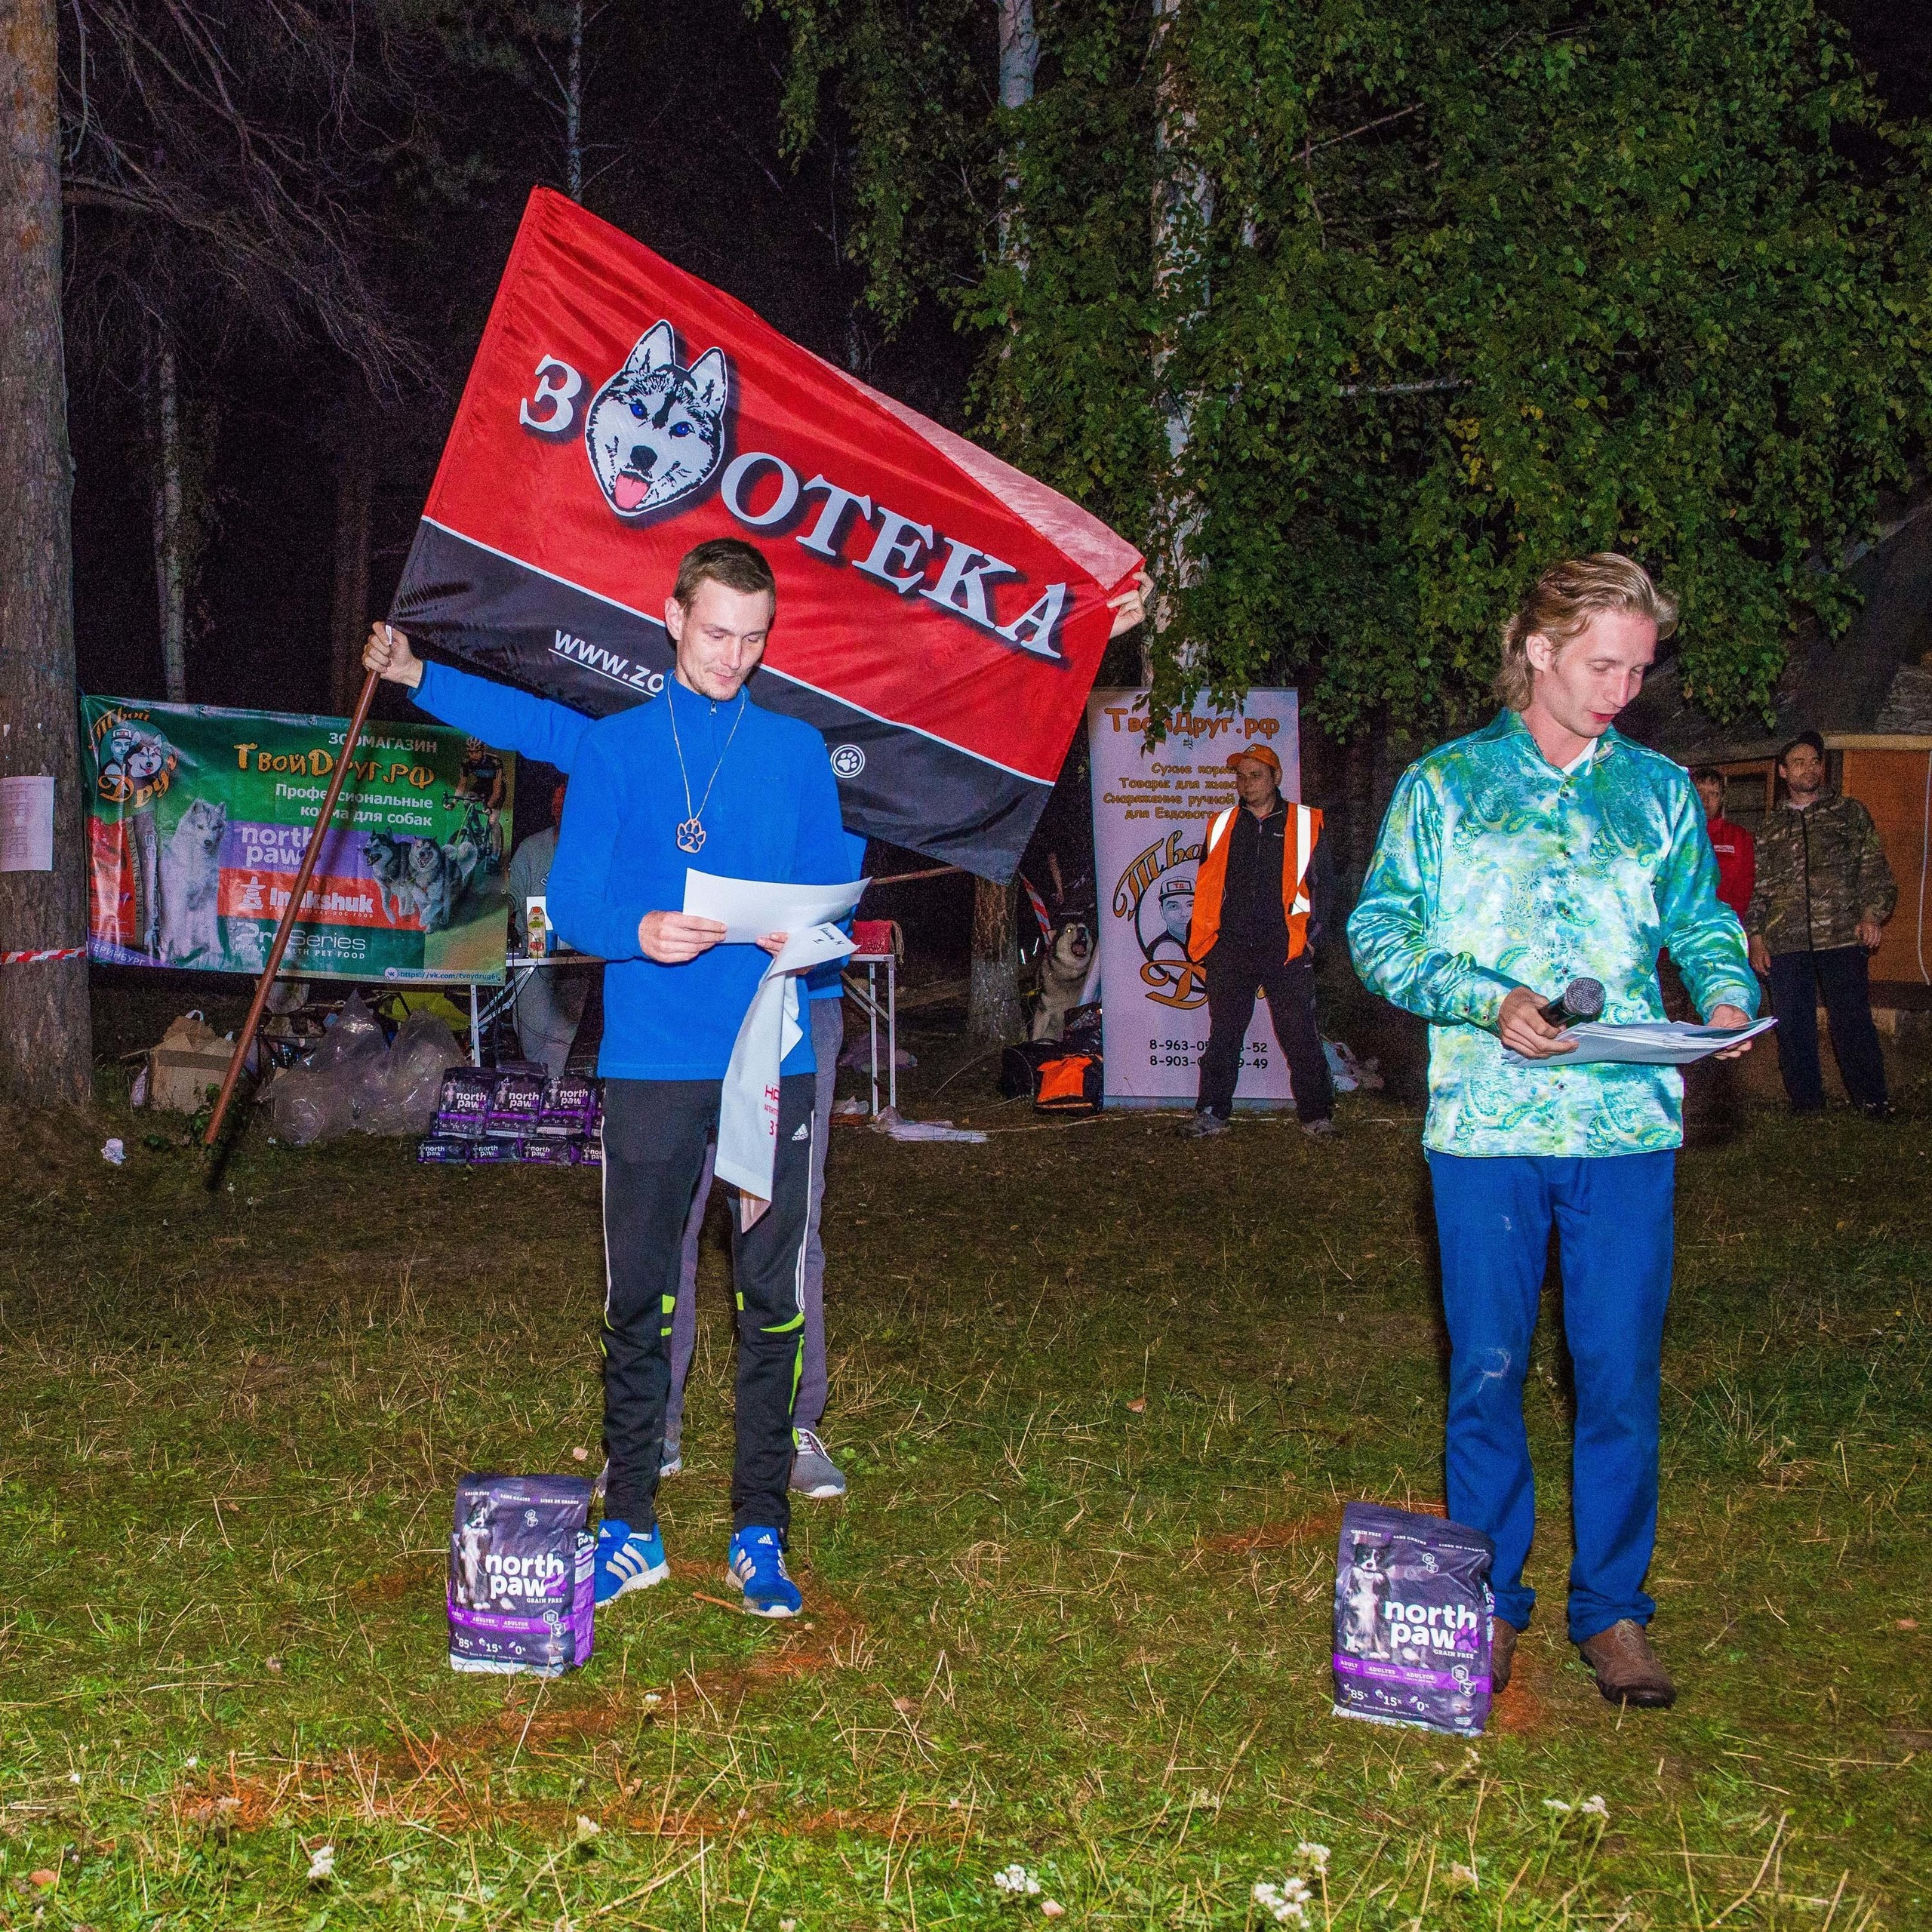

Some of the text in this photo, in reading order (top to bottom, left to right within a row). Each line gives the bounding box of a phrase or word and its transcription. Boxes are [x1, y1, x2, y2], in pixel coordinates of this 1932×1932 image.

[555, 629, 665, 693] www.zo
[1151, 762, 1192, 776] Сухие
[1118, 777, 1238, 792] Товары для живо
[275, 783, 434, 810] Професиональные
[1103, 792, 1235, 807] Снаряжение ручной
[300, 805, 432, 827] кома для собак
[1124, 809, 1150, 820] для
[242, 826, 314, 848] north
[245, 844, 303, 867] paw
[1112, 829, 1203, 921] Тво
[337, 951, 365, 959] FOOD
[456, 1092, 486, 1101] north
[509, 1092, 540, 1100] north
[559, 1088, 588, 1097] north
[457, 1100, 479, 1109] paw
[509, 1100, 531, 1108] paw
[560, 1097, 582, 1106] paw
[485, 1553, 565, 1577] north
[490, 1574, 548, 1600] paw
[1383, 1601, 1478, 1630] north
[1390, 1623, 1456, 1651] paw
[1433, 1649, 1456, 1657] GRAIN
[1340, 1660, 1358, 1669] ADULT
[1368, 1666, 1396, 1675] ADULTES
